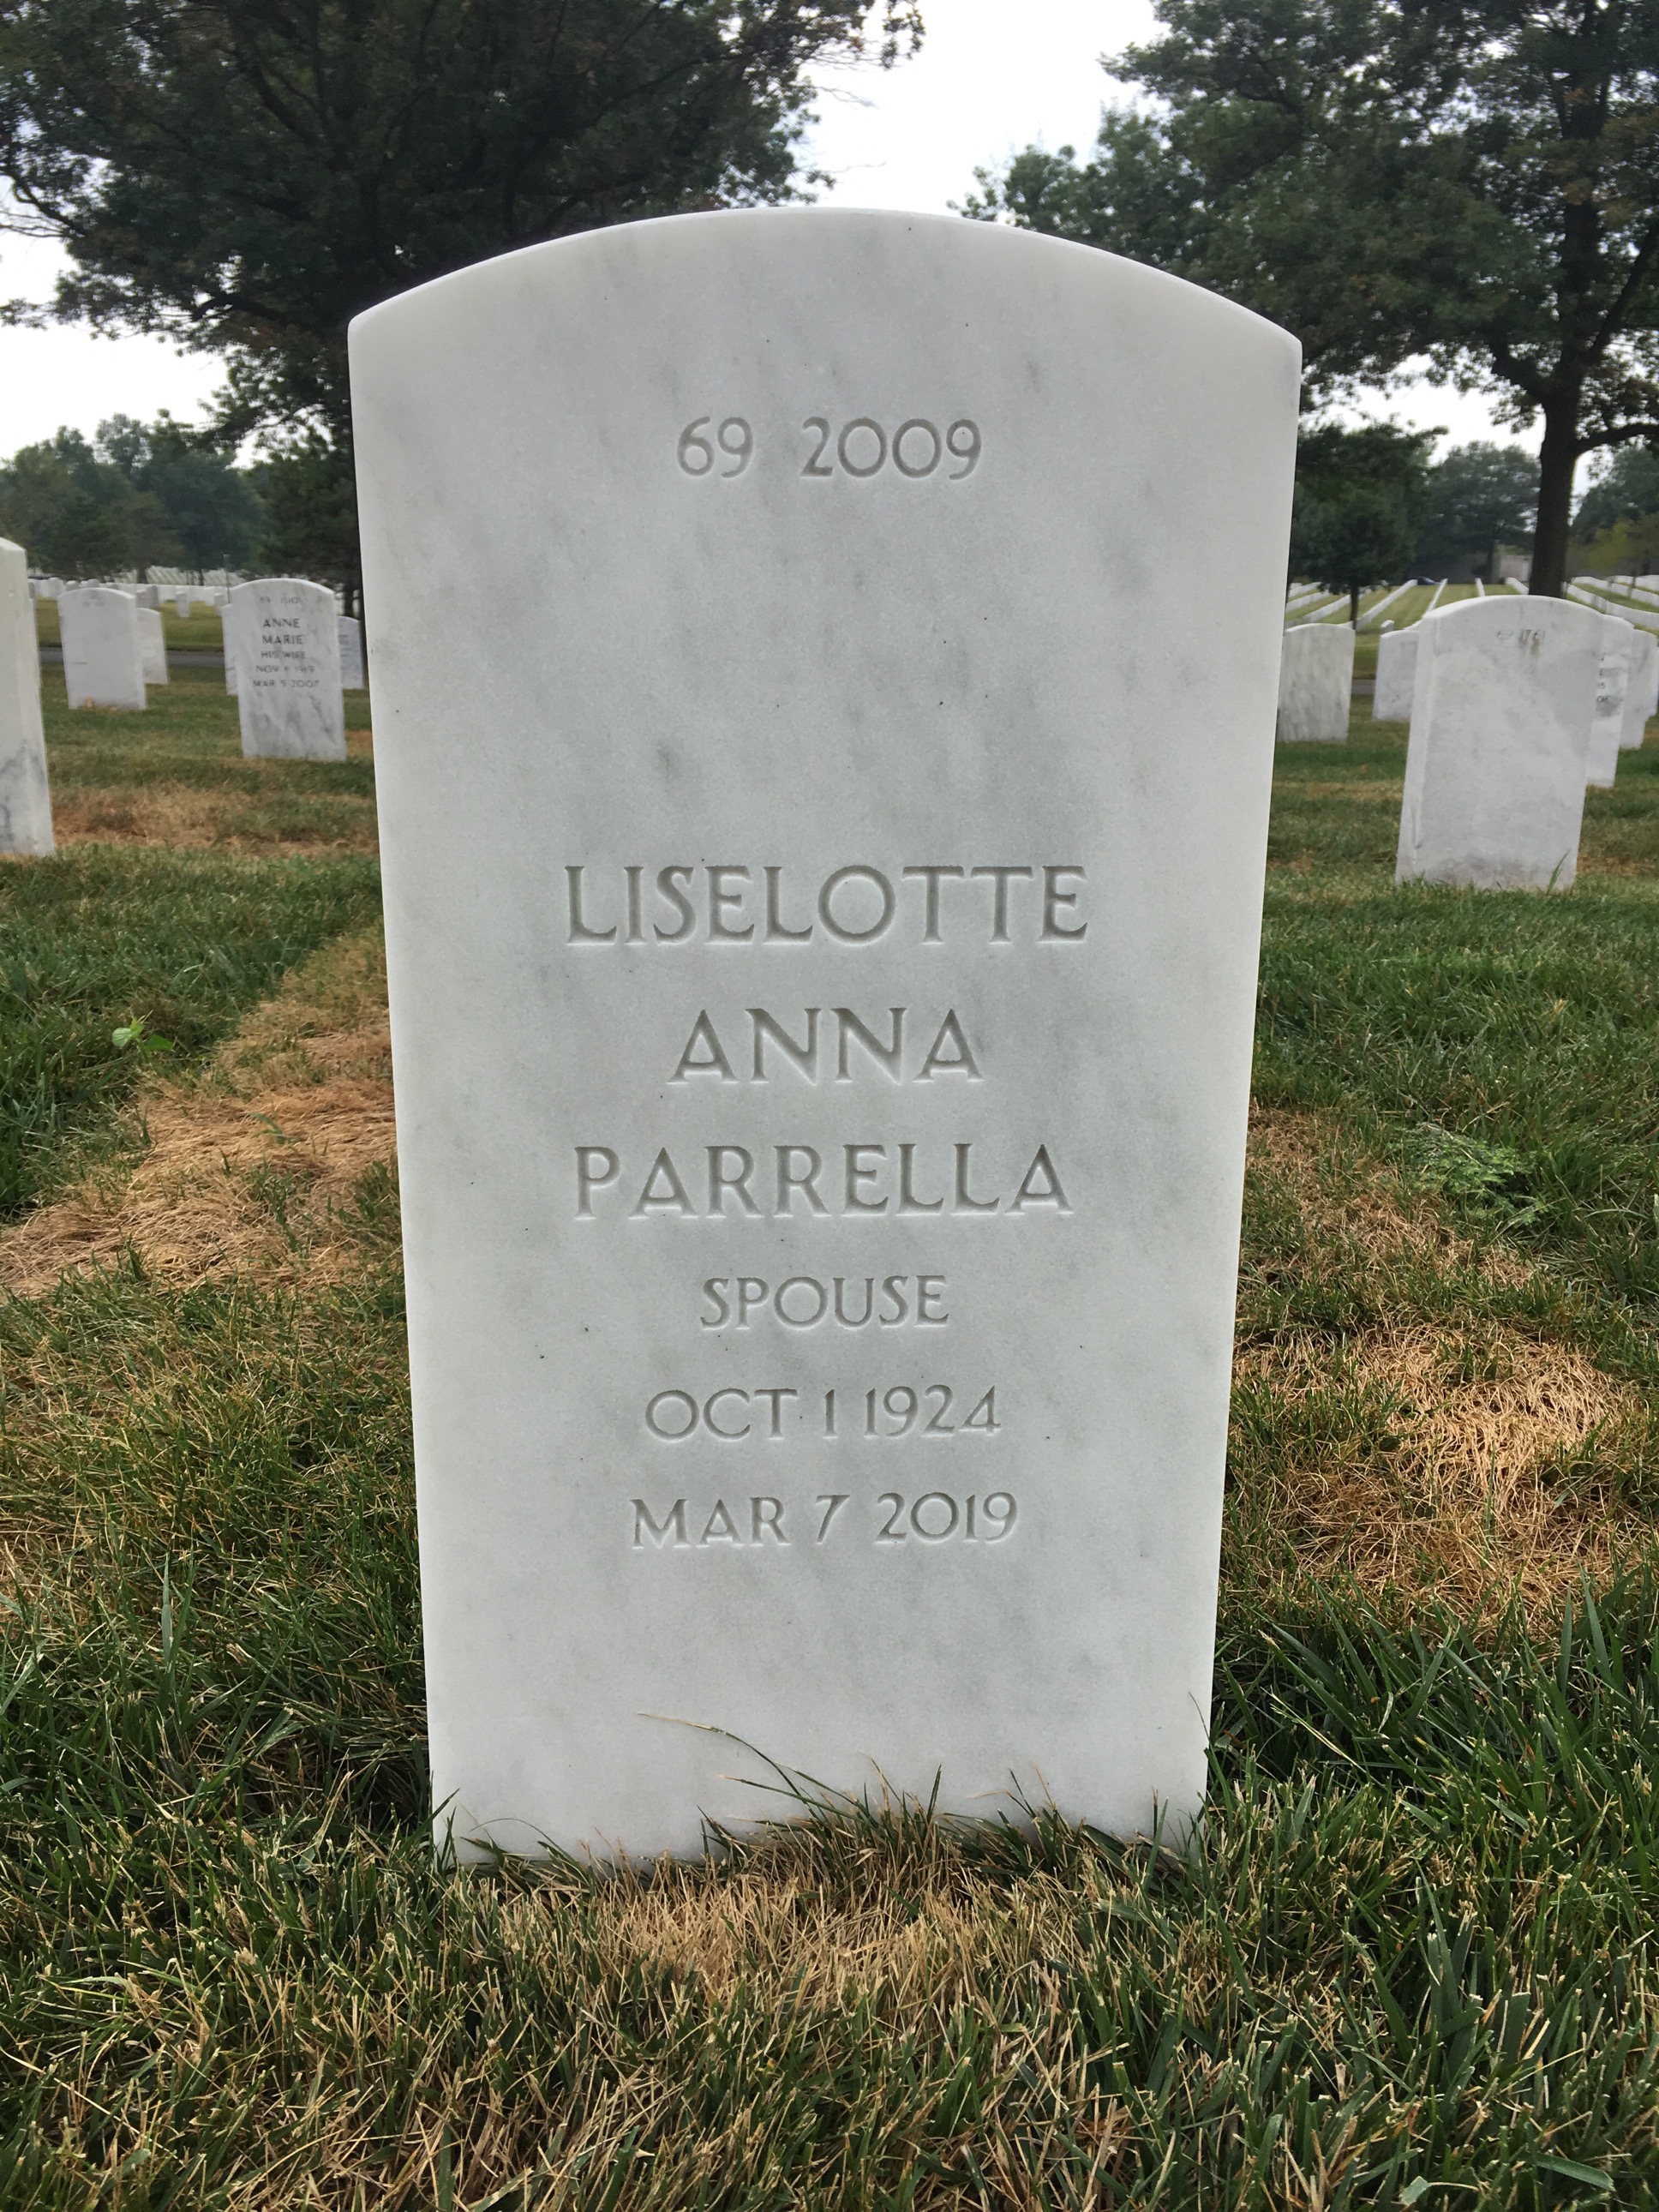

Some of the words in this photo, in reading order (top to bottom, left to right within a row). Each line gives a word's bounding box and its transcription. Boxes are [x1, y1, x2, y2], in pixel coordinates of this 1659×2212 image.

[677, 416, 754, 479] 69
[800, 416, 982, 481] 2009
[262, 634, 304, 645] MARIE
[263, 617, 301, 629] ANNE
[565, 865, 1088, 945] LISELOTTE
[668, 1008, 984, 1085] ANNA
[573, 1143, 1074, 1220] PARRELLA
[700, 1274, 949, 1330] SPOUSE
[645, 1388, 799, 1442] OCT
[823, 1388, 839, 1440] 1
[864, 1384, 1002, 1440] 1924
[630, 1496, 792, 1550] MAR
[816, 1494, 850, 1545] 7
[873, 1491, 1018, 1544] 2019
